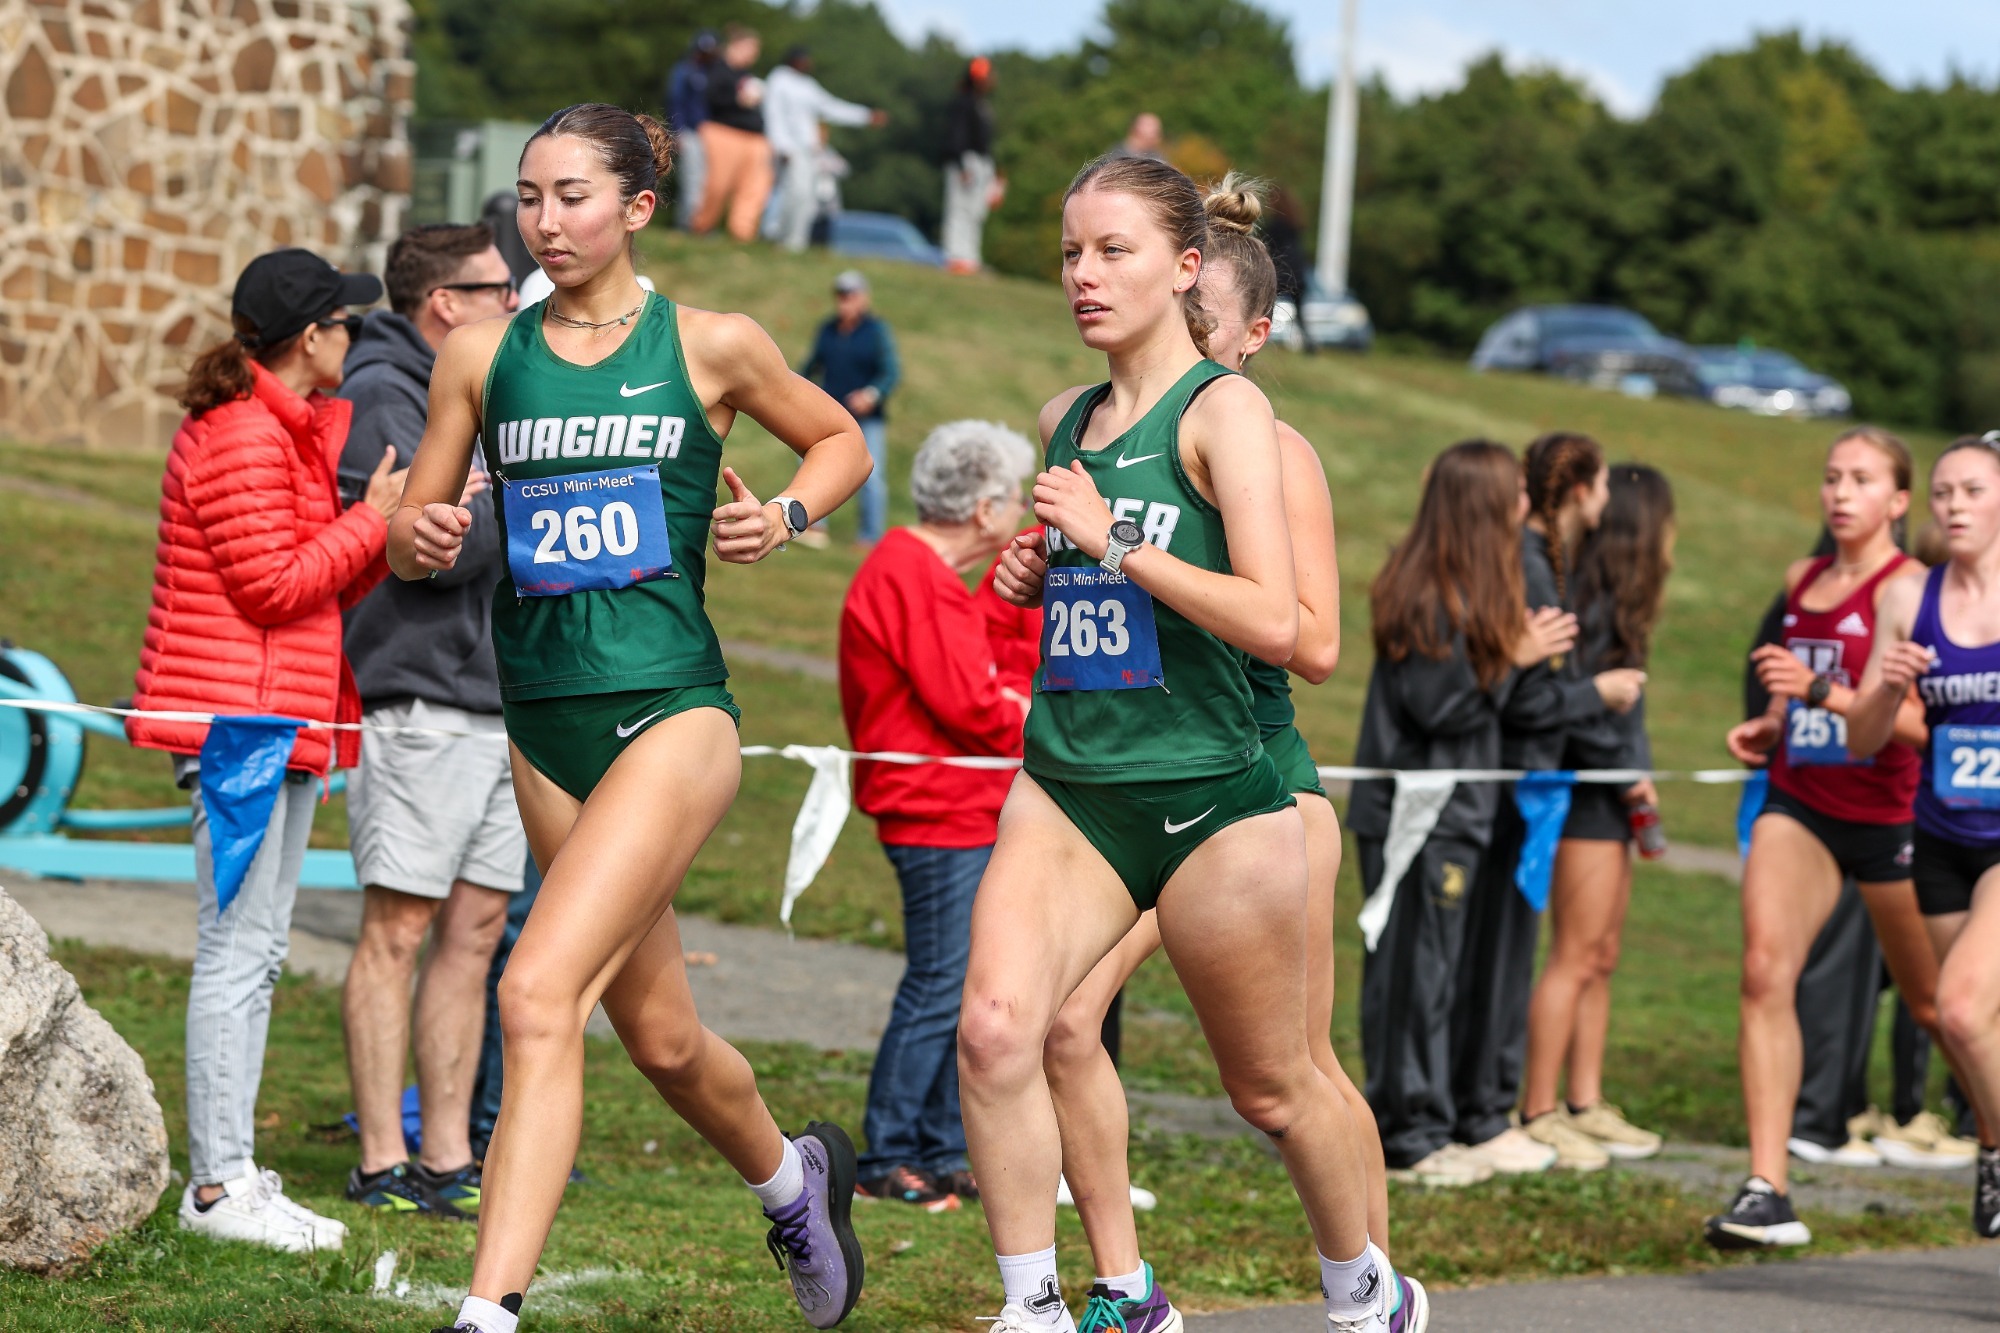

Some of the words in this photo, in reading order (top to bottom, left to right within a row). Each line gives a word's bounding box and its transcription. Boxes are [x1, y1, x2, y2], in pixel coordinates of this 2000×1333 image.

[498, 414, 686, 465] WAGNER
[521, 482, 559, 498] CCSU
[563, 474, 635, 494] Mini-Meet
[531, 501, 639, 564] 260
[1049, 573, 1070, 587] CCSU
[1073, 572, 1128, 586] Mini-Meet
[1050, 599, 1130, 657] 263
